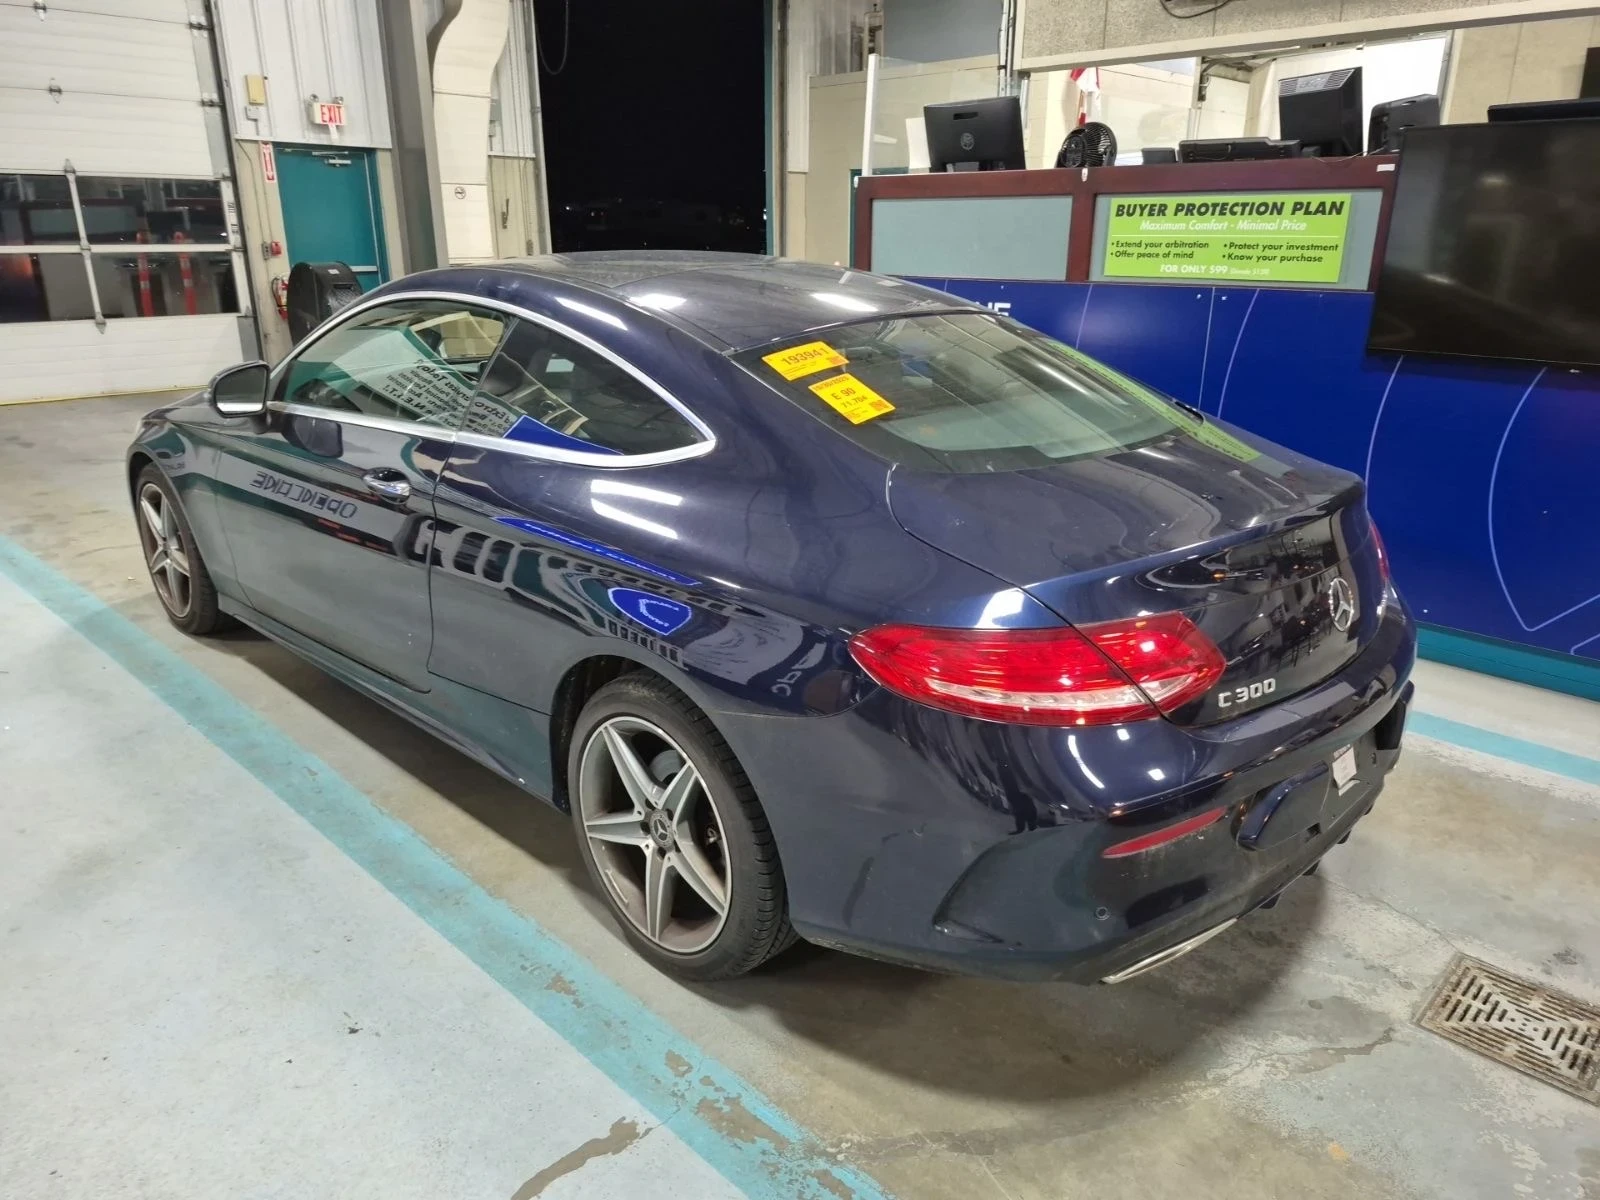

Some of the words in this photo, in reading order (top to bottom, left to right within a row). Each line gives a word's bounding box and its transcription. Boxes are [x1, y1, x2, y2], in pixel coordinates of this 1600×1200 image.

[321, 105, 342, 123] EXIT
[1115, 203, 1168, 217] BUYER
[1174, 201, 1285, 217] PROTECTION
[1290, 200, 1344, 216] PLAN
[1140, 220, 1186, 231] Maximum
[1189, 219, 1228, 231] Comfort
[1237, 219, 1279, 231] Minimal
[1281, 219, 1307, 231] Price
[1115, 240, 1142, 249] Extend
[1144, 242, 1163, 250] your
[1164, 240, 1209, 249] arbitration
[1228, 242, 1259, 250] Protect
[1261, 244, 1282, 252] your
[1285, 243, 1339, 252] investment
[1114, 250, 1134, 258] Offer
[1136, 252, 1160, 260] peace
[1162, 250, 1171, 259] of
[1173, 251, 1194, 259] mind
[1227, 252, 1253, 261] Know
[1256, 255, 1277, 263] your
[1279, 253, 1323, 264] purchase
[1160, 264, 1178, 273] FOR
[1180, 264, 1207, 273] ONLY
[781, 347, 829, 366] 193941
[831, 392, 841, 401] E
[840, 386, 856, 397] 90
[1218, 691, 1232, 707] C
[1235, 678, 1276, 703] 300
